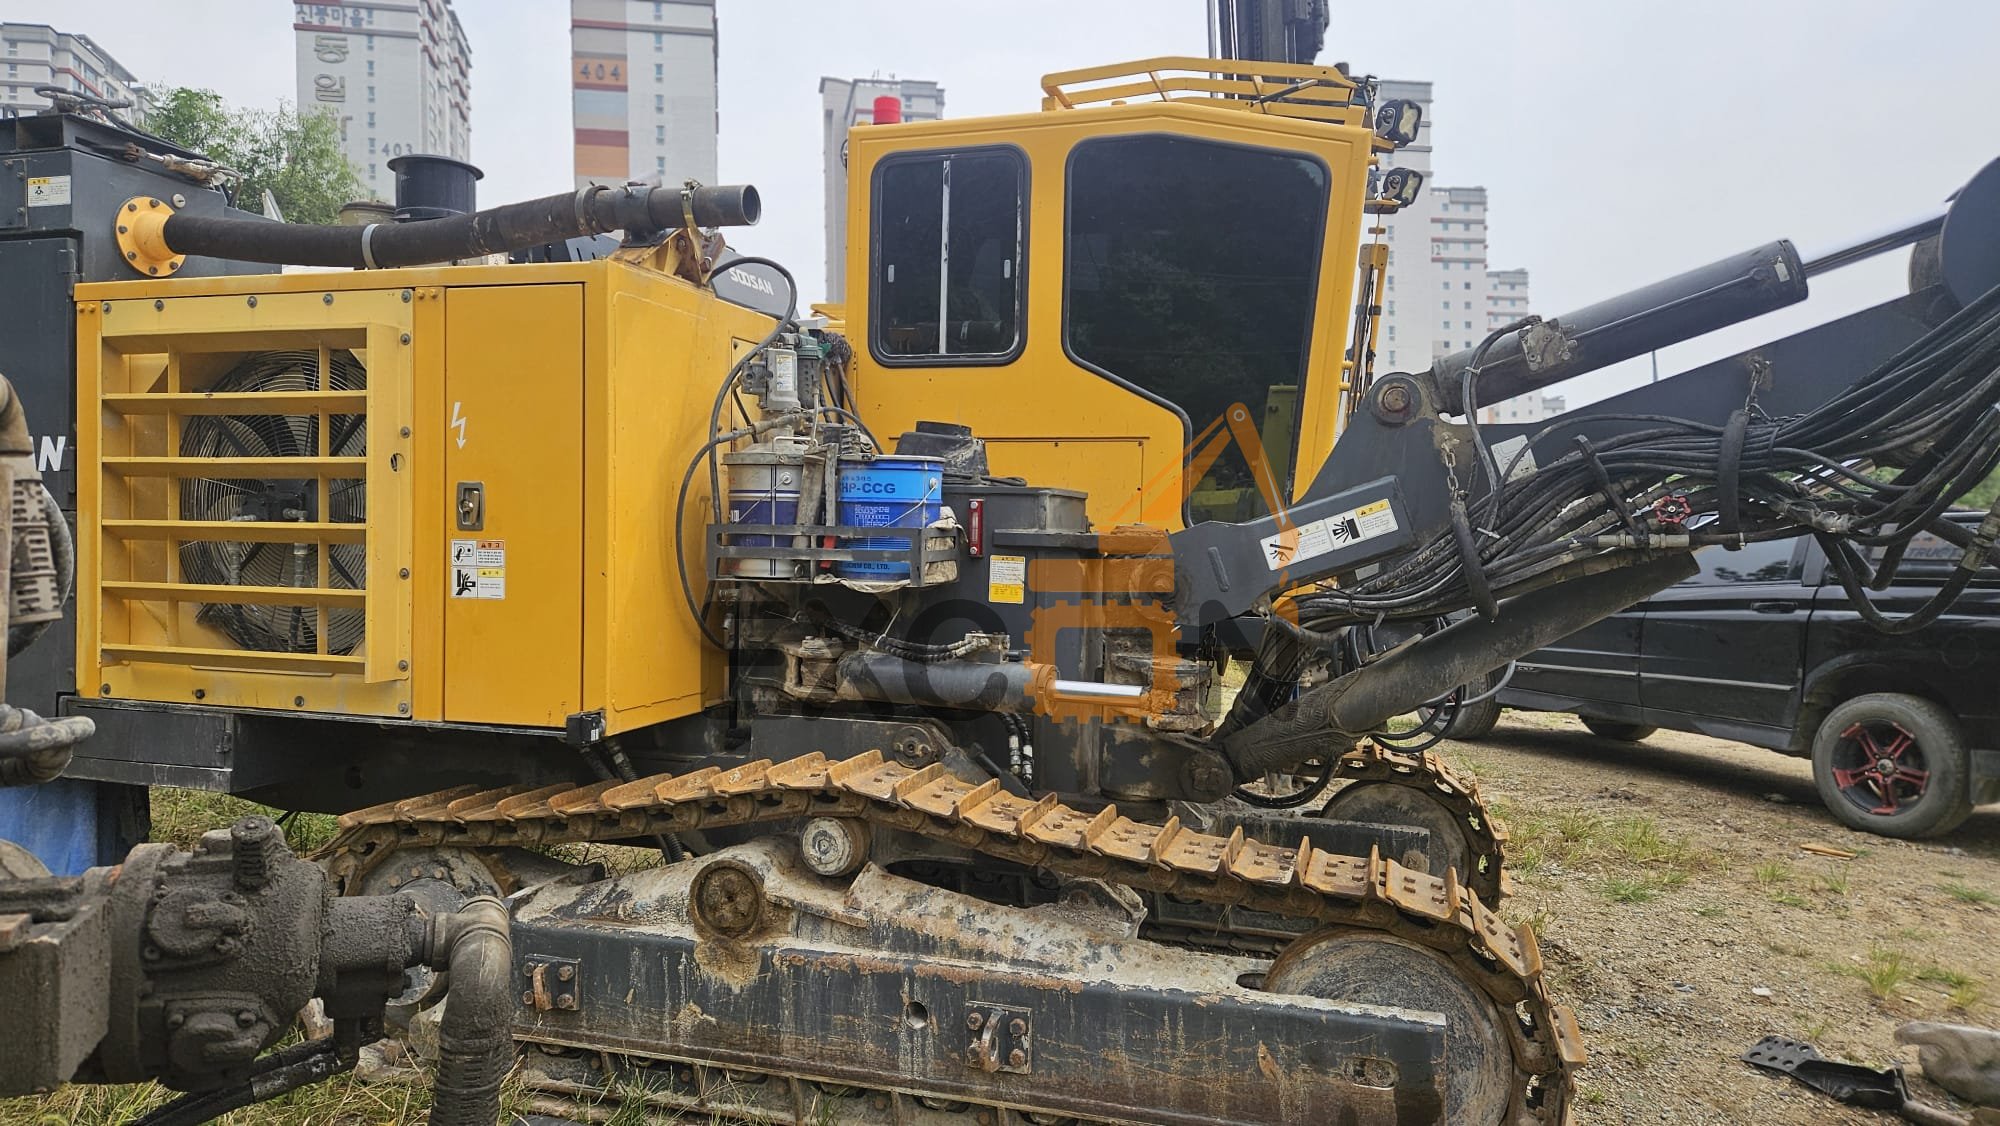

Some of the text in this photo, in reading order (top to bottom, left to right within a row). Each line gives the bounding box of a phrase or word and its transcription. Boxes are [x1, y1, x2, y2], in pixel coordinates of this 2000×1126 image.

[580, 63, 621, 81] 404
[381, 143, 413, 156] 403
[728, 267, 774, 296] SOOSAN
